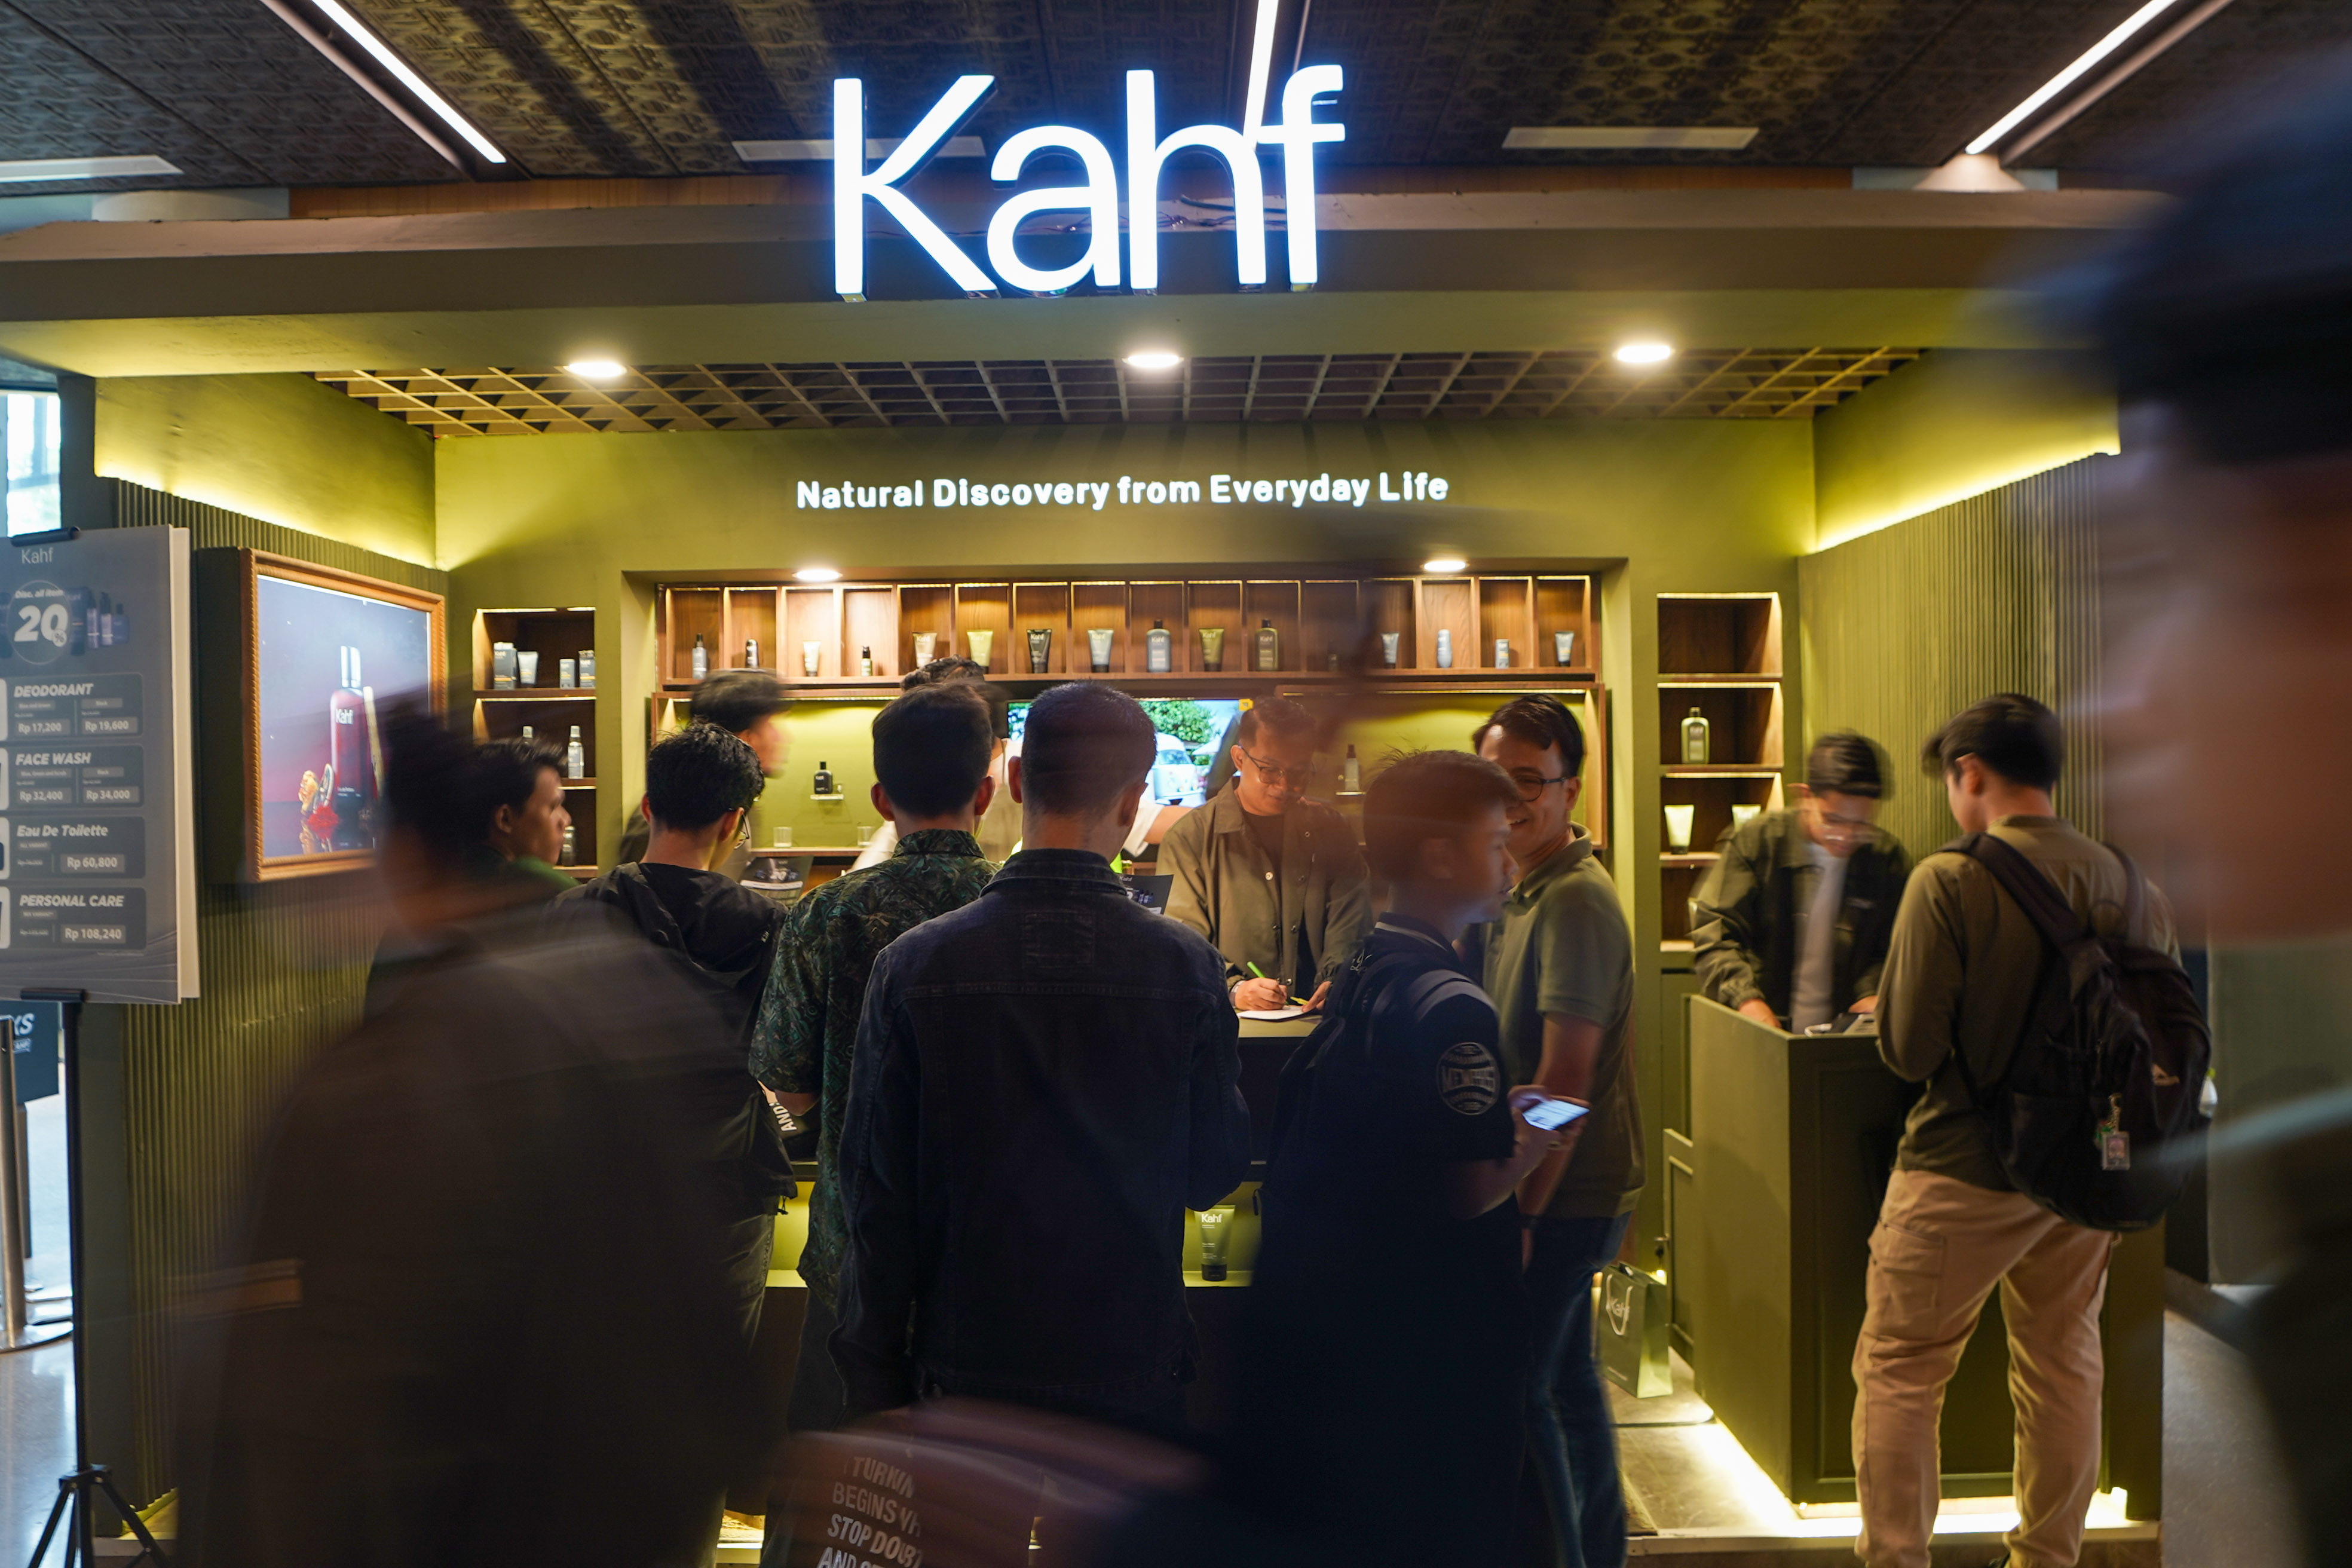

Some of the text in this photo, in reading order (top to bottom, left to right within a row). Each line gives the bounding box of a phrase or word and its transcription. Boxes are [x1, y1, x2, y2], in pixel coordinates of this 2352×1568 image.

[834, 65, 1346, 294] Kahf
[797, 471, 1448, 511] Natural Discovery from Everyday Life
[22, 547, 53, 564] Kahf
[14, 684, 93, 697] DEODORANT
[336, 709, 354, 724] Kahf
[19, 724, 29, 734] Rp
[85, 721, 129, 733] Rp 19,600
[16, 752, 91, 765] FACE WASH
[20, 791, 63, 802] Rp 32,400
[86, 790, 130, 801] Rp 34,000
[17, 824, 108, 837] Eau De Toilette
[67, 856, 117, 870] Rp 60,800
[19, 895, 124, 907] PERSONAL CARE
[65, 928, 121, 941] Rp 108,240
[1201, 1214, 1222, 1223] Kahf
[832, 1482, 897, 1524] BEGINS
[827, 1514, 872, 1547] STOP
